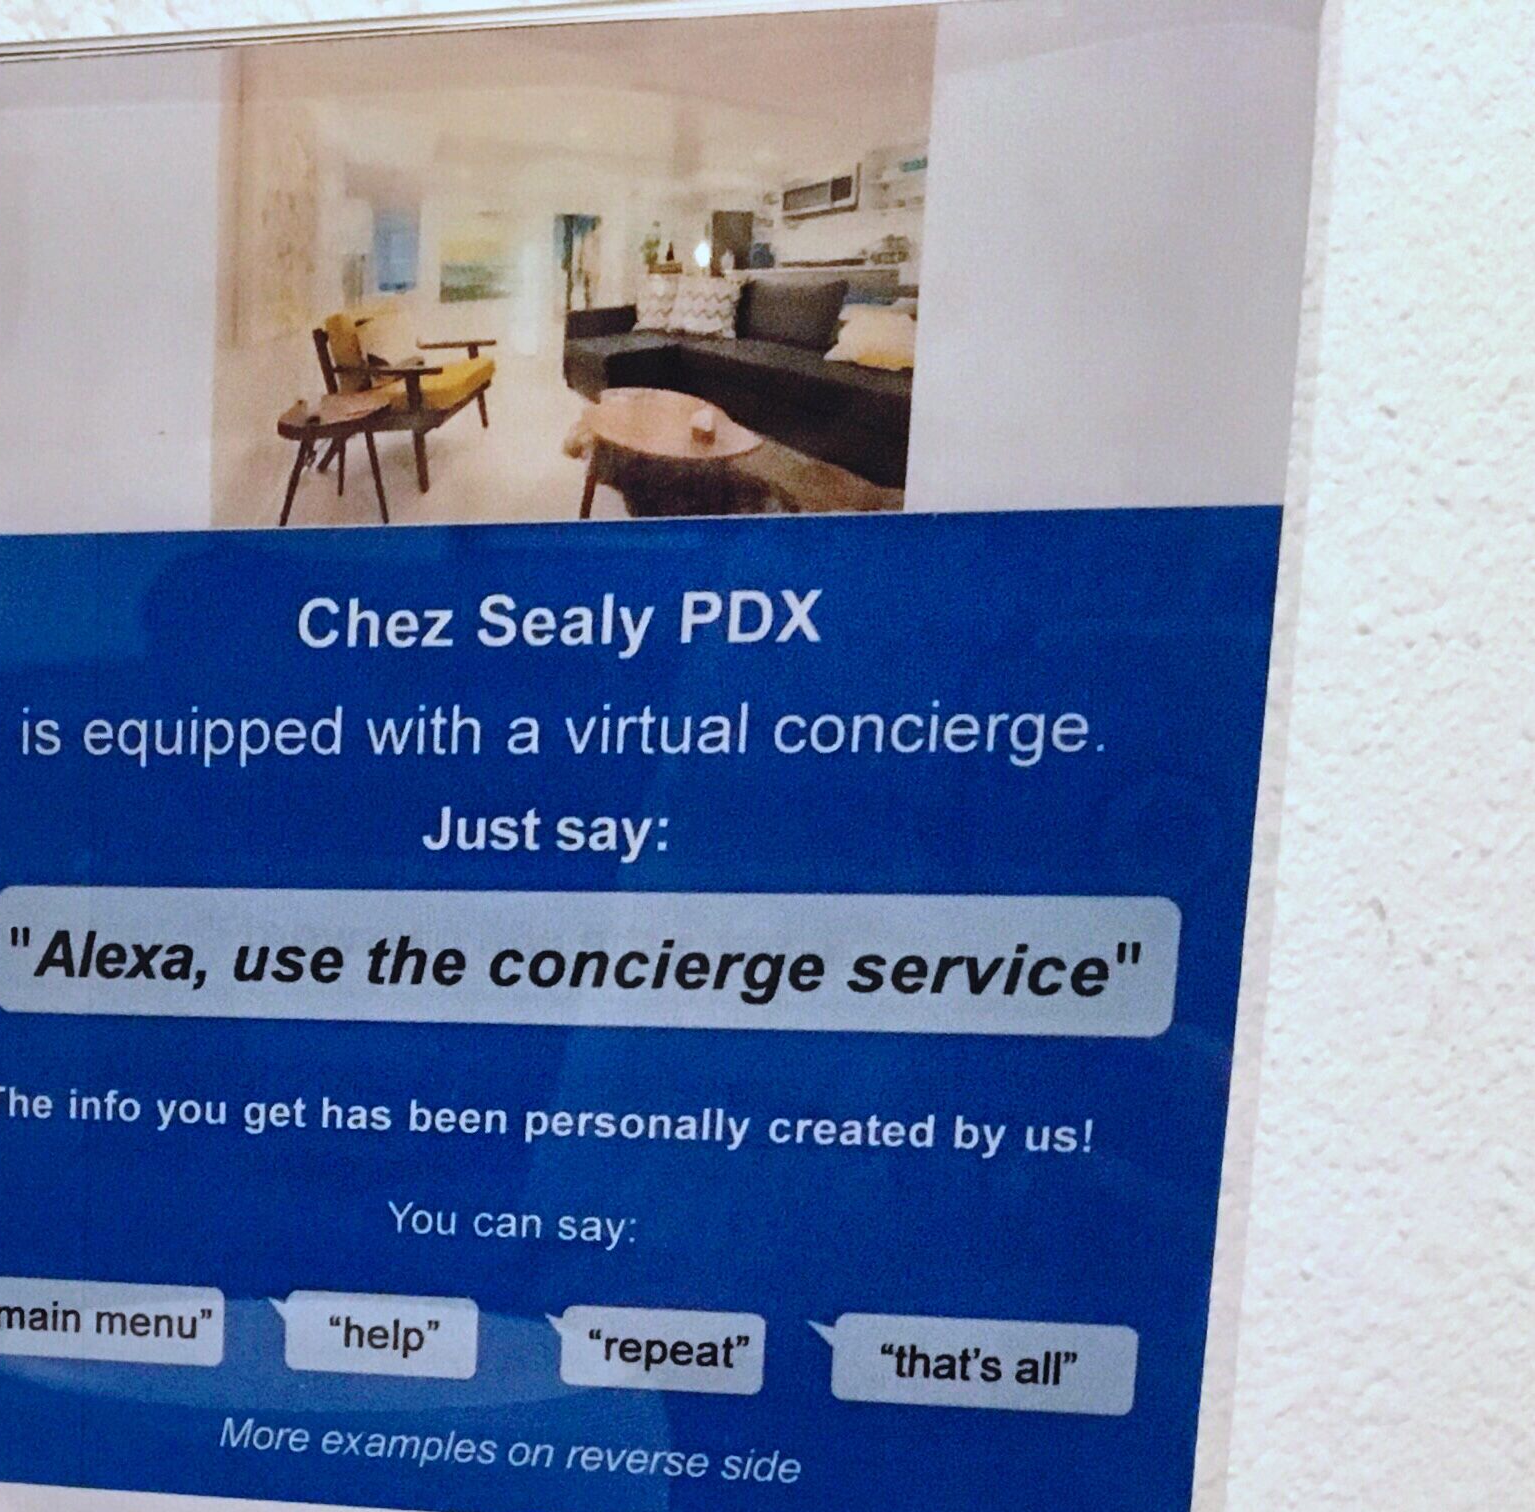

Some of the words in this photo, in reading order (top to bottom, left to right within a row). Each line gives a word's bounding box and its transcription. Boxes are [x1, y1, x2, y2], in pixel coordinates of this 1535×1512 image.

[299, 598, 453, 648] Chez
[478, 594, 654, 658] Sealy
[681, 590, 821, 643] PDX
[23, 708, 61, 755] is
[84, 706, 342, 767] equipped
[367, 705, 481, 754] with
[508, 717, 539, 754] a
[566, 702, 748, 754] virtual
[774, 700, 1103, 767] concierge.
[423, 806, 540, 850] Just
[557, 817, 668, 863] say:
[234, 946, 344, 983] use
[368, 935, 466, 986] the
[489, 939, 825, 1005] concierge
[70, 1089, 140, 1121] info
[157, 1100, 226, 1131] you
[244, 1098, 305, 1134] get
[322, 1097, 391, 1130] has
[410, 1100, 507, 1133] been
[525, 1108, 749, 1150] personally
[769, 1115, 935, 1147] created
[954, 1116, 1005, 1158] by
[1026, 1119, 1092, 1152] us!
[389, 1202, 456, 1235] You
[474, 1213, 542, 1238] can
[559, 1216, 635, 1251] say:
[220, 1417, 310, 1452] More
[322, 1431, 497, 1467] examples
[508, 1442, 554, 1467] on
[566, 1446, 709, 1477] reverse
[721, 1450, 801, 1483] side
